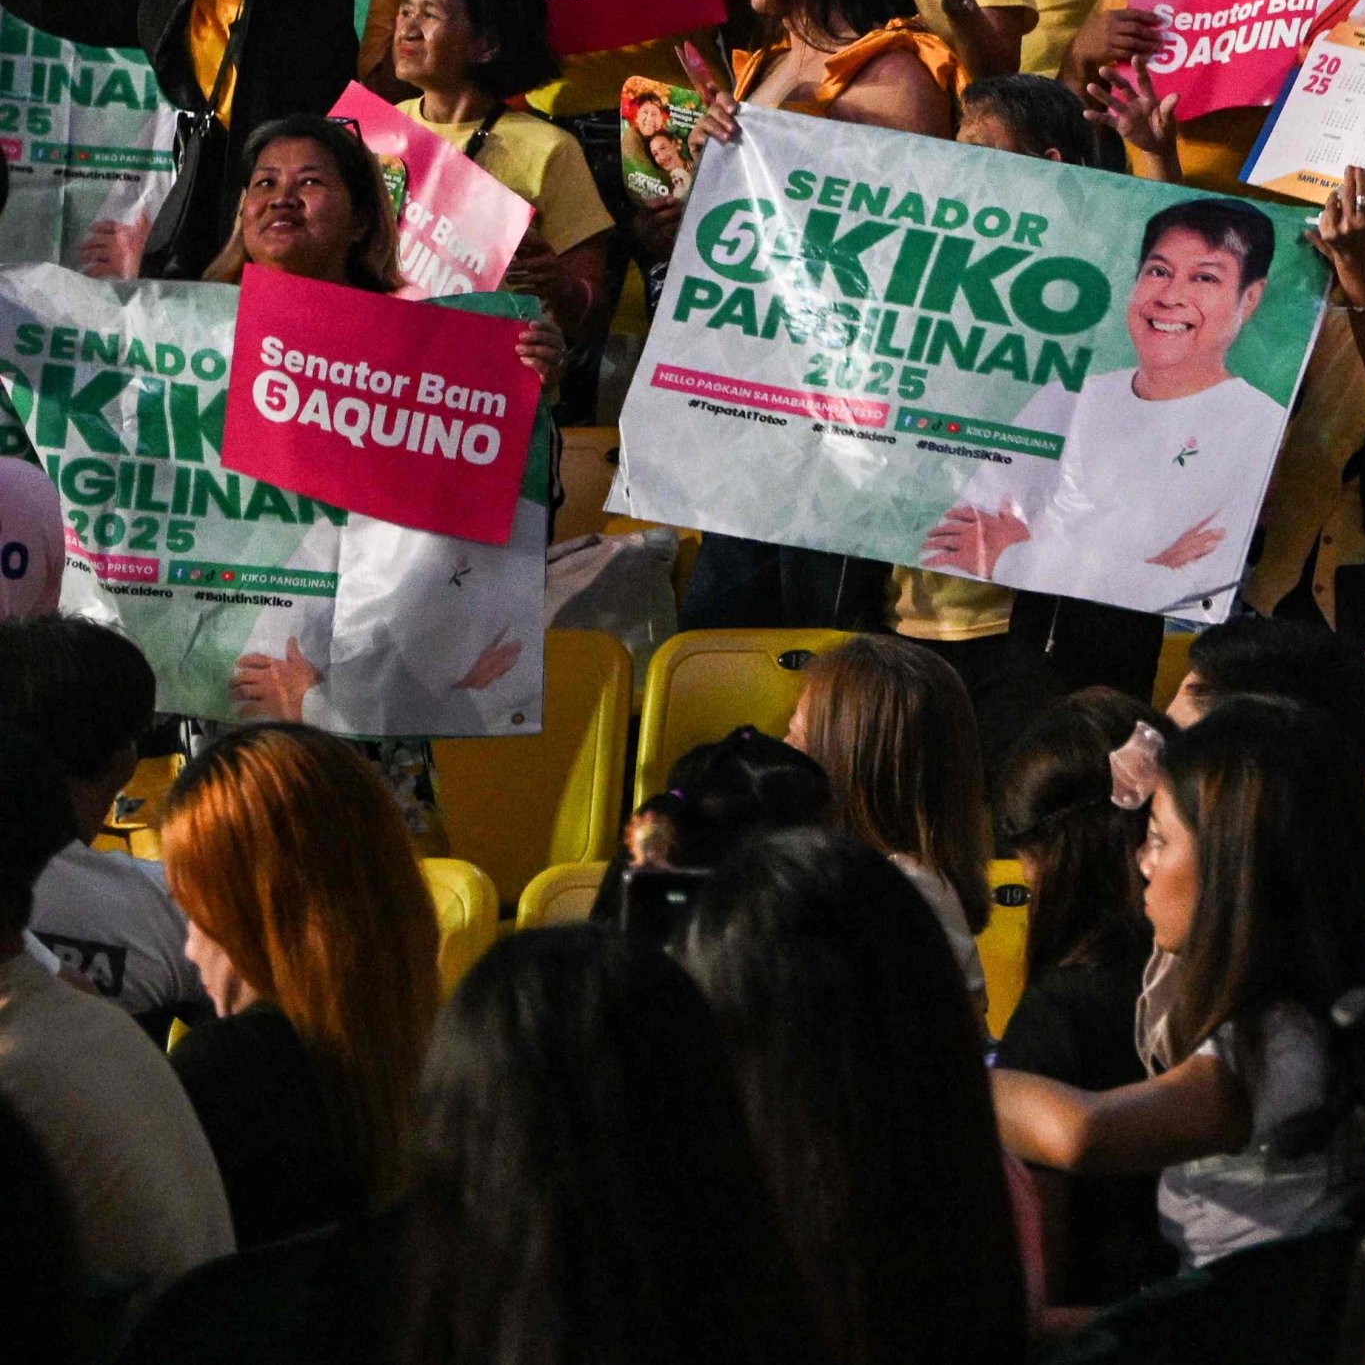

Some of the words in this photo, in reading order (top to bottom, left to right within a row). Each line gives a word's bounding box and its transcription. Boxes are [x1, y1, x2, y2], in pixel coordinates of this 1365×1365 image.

[1302, 73, 1333, 96] 25
[1311, 53, 1342, 76] 20
[784, 168, 1049, 248] SENADOR
[430, 214, 487, 276] Bam
[802, 209, 1112, 336] KIKO
[14, 324, 228, 382] SENADO
[673, 275, 1094, 393] PANGILINAN
[260, 335, 410, 398] Senator
[416, 372, 507, 417] Bam
[659, 370, 692, 387] HELLO
[694, 376, 752, 398] PAGKAIN
[753, 389, 769, 401] SA
[802, 352, 926, 399] 2025
[298, 400, 501, 466] AQUINO
[688, 397, 788, 428] #TapatAtTotoo
[916, 437, 1013, 466] #BalutinSiKiko
[67, 509, 196, 553] 2025
[107, 558, 154, 577] PRESYO
[241, 572, 266, 586] KIKO
[268, 574, 336, 590] PANGILINAN
[194, 589, 293, 609] #BalutinSiKiko
